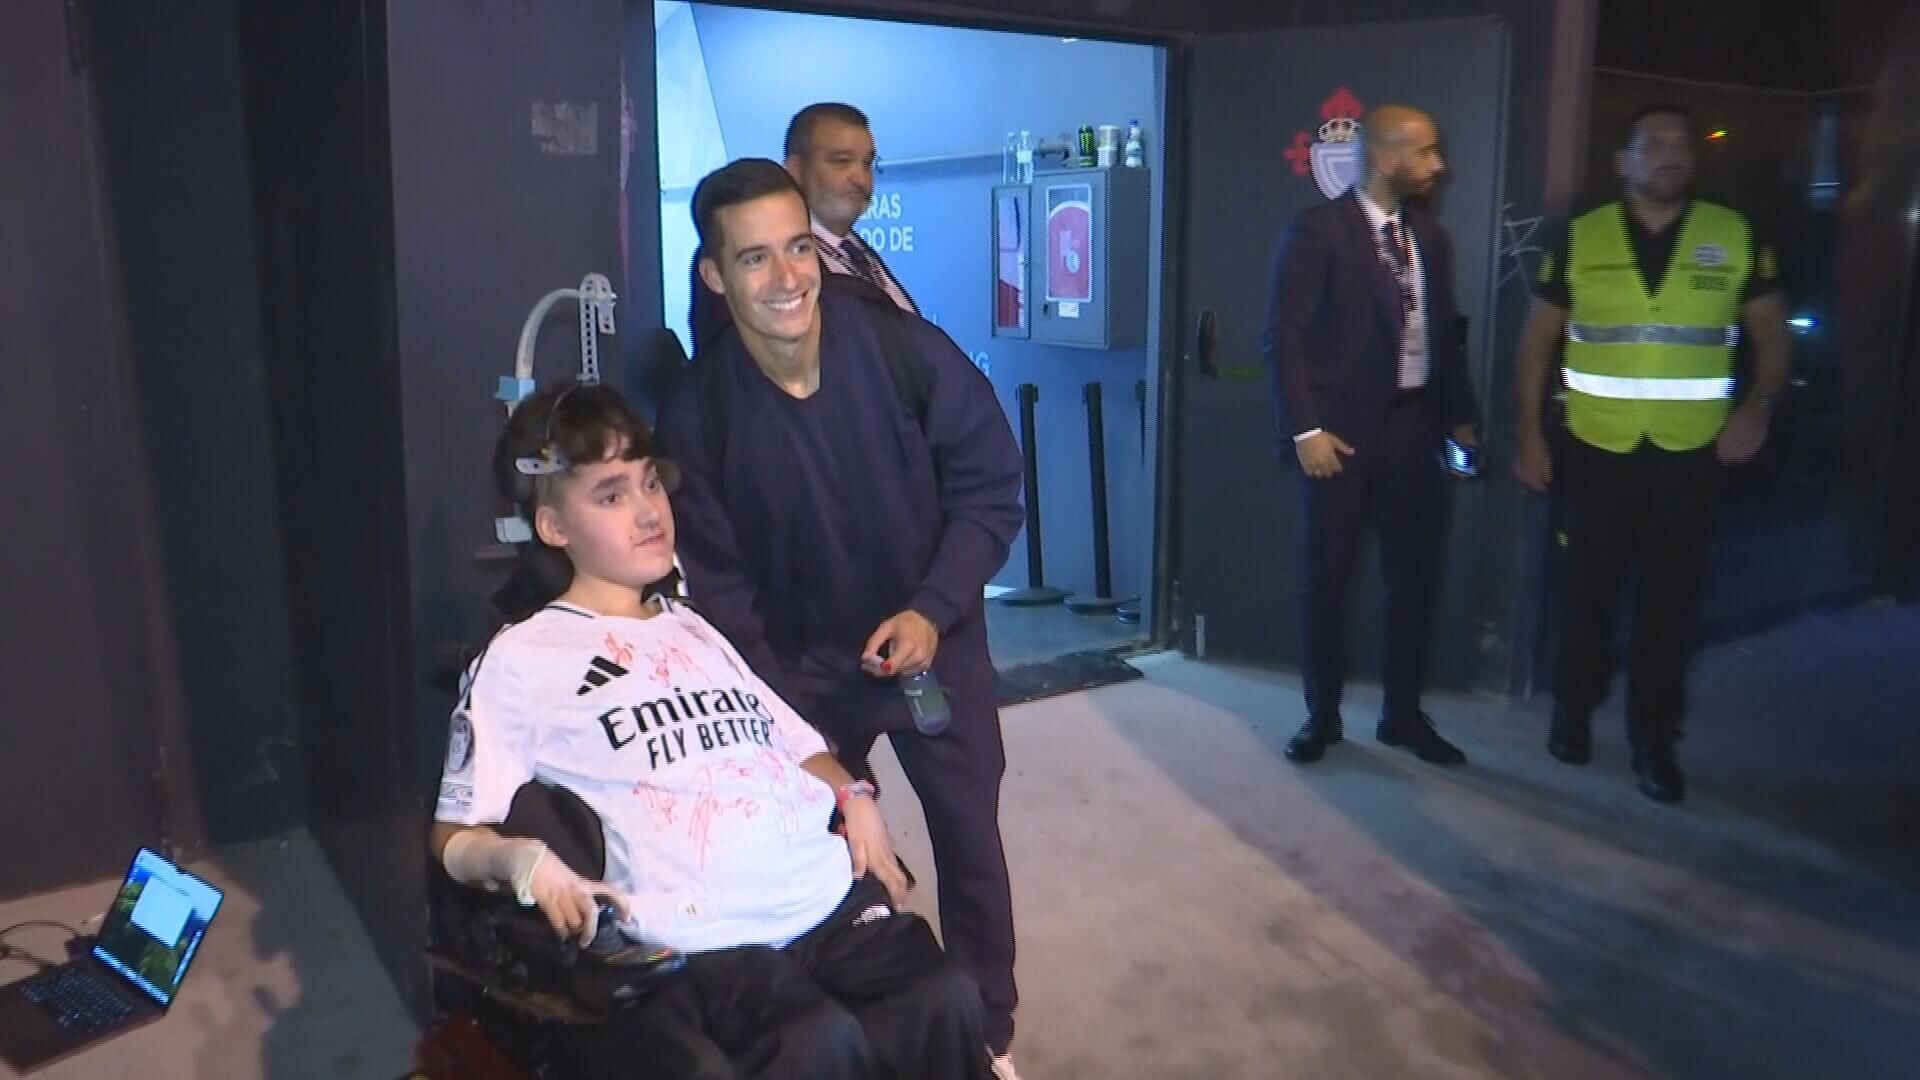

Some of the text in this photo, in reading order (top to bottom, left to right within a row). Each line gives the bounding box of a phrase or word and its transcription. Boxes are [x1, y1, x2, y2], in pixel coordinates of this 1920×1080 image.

[862, 192, 902, 219] RAS
[889, 226, 914, 252] DE
[646, 717, 773, 770] FLY BETTER
